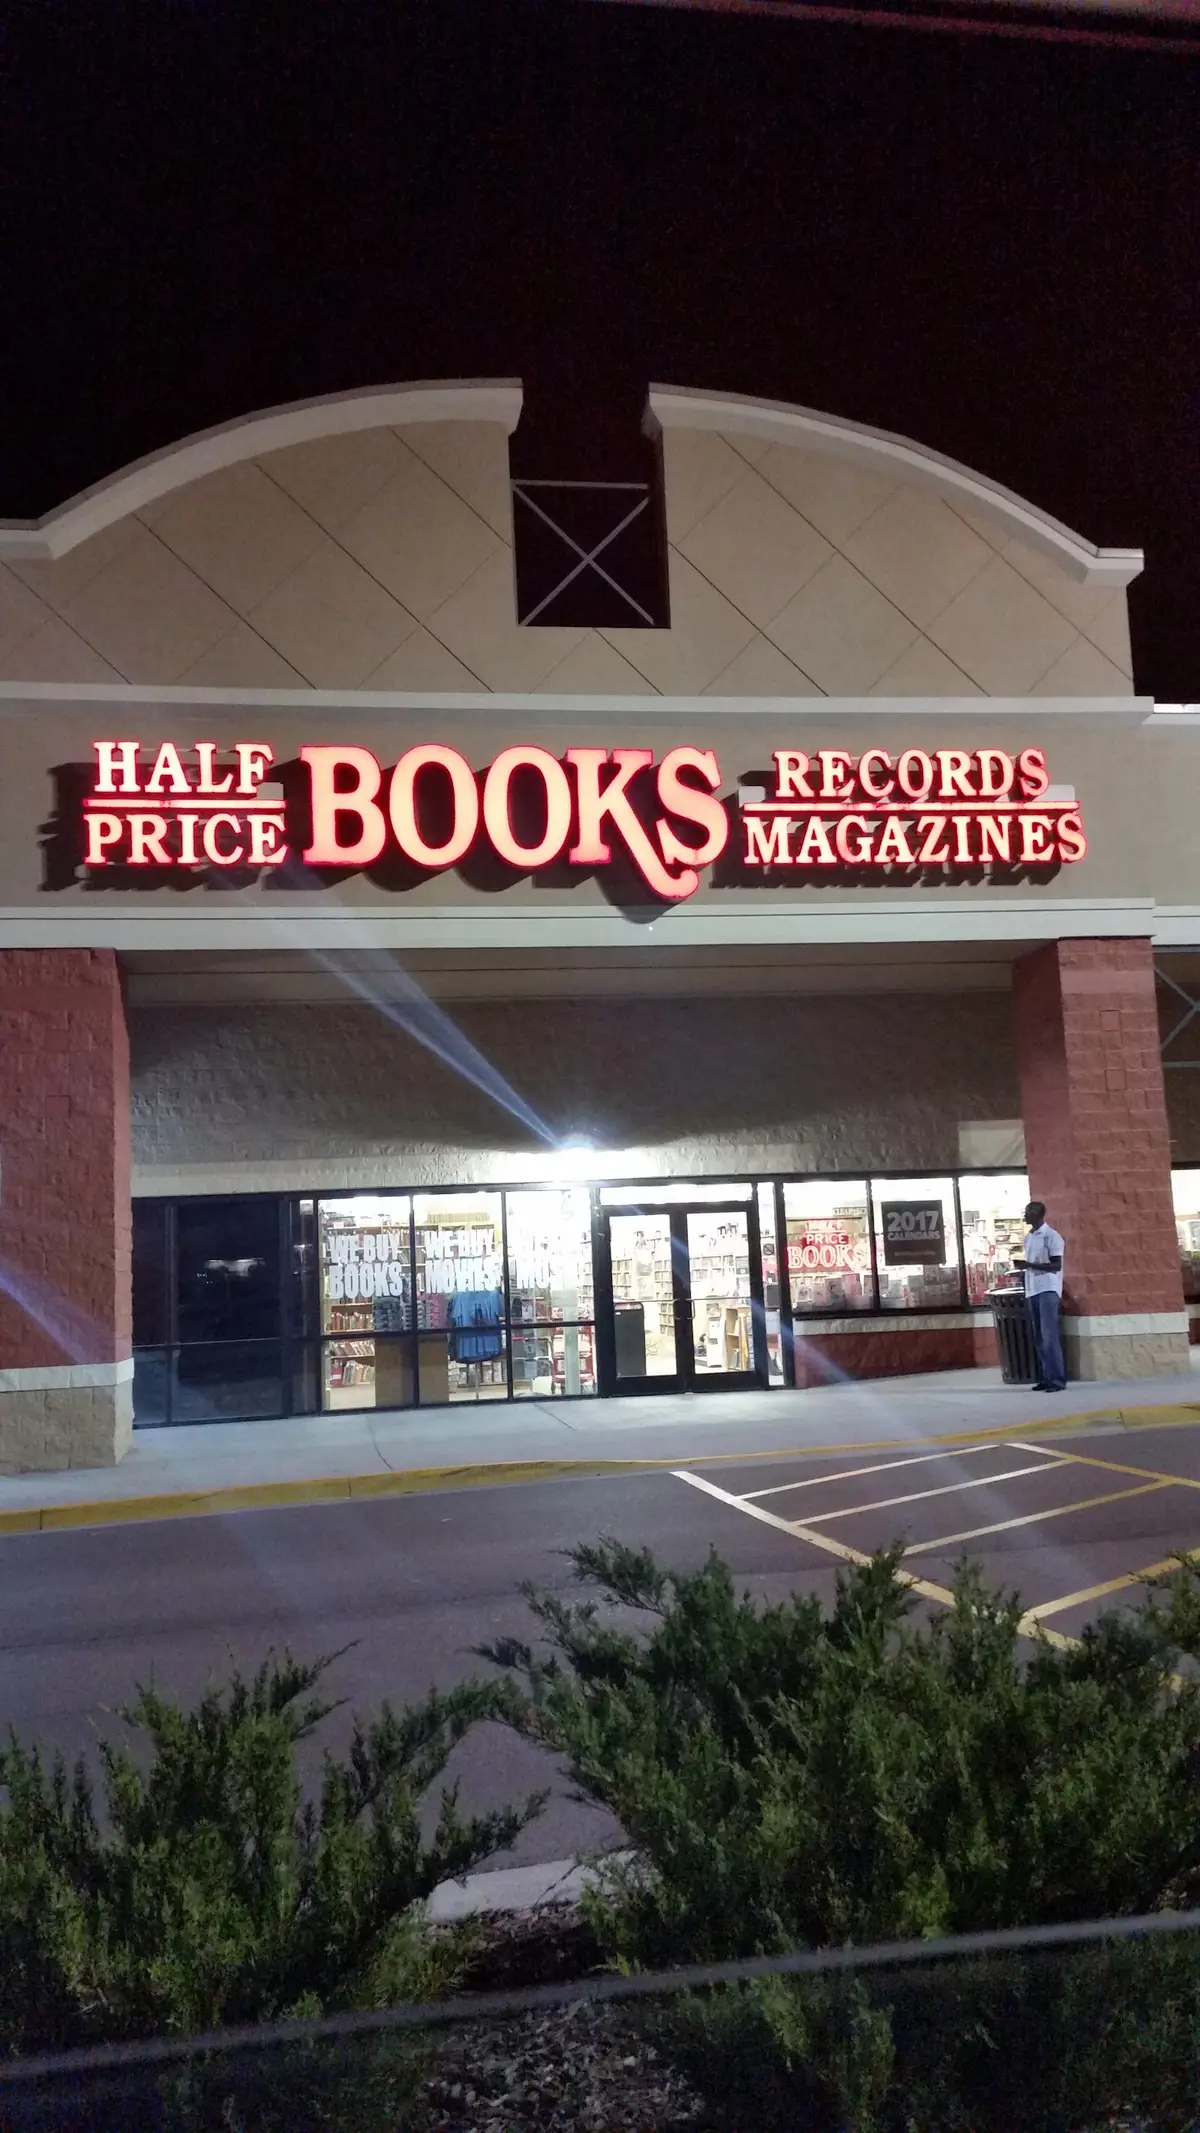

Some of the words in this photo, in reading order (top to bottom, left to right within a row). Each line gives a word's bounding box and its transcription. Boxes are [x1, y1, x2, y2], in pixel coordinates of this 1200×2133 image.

[92, 740, 275, 795] HALF
[772, 747, 1051, 799] RECORDS
[299, 743, 729, 900] BOOKS
[742, 810, 1087, 865] MAGAZINES
[82, 812, 289, 867] PRICE
[887, 1211, 939, 1231] 2017
[887, 1230, 940, 1241] CALENDARS
[328, 1234, 360, 1262] WE
[363, 1232, 400, 1262] BUY
[424, 1230, 454, 1259] WE
[806, 1233, 848, 1245] PRICE
[787, 1244, 868, 1272] BOOKS
[329, 1262, 403, 1300] BOOKS
